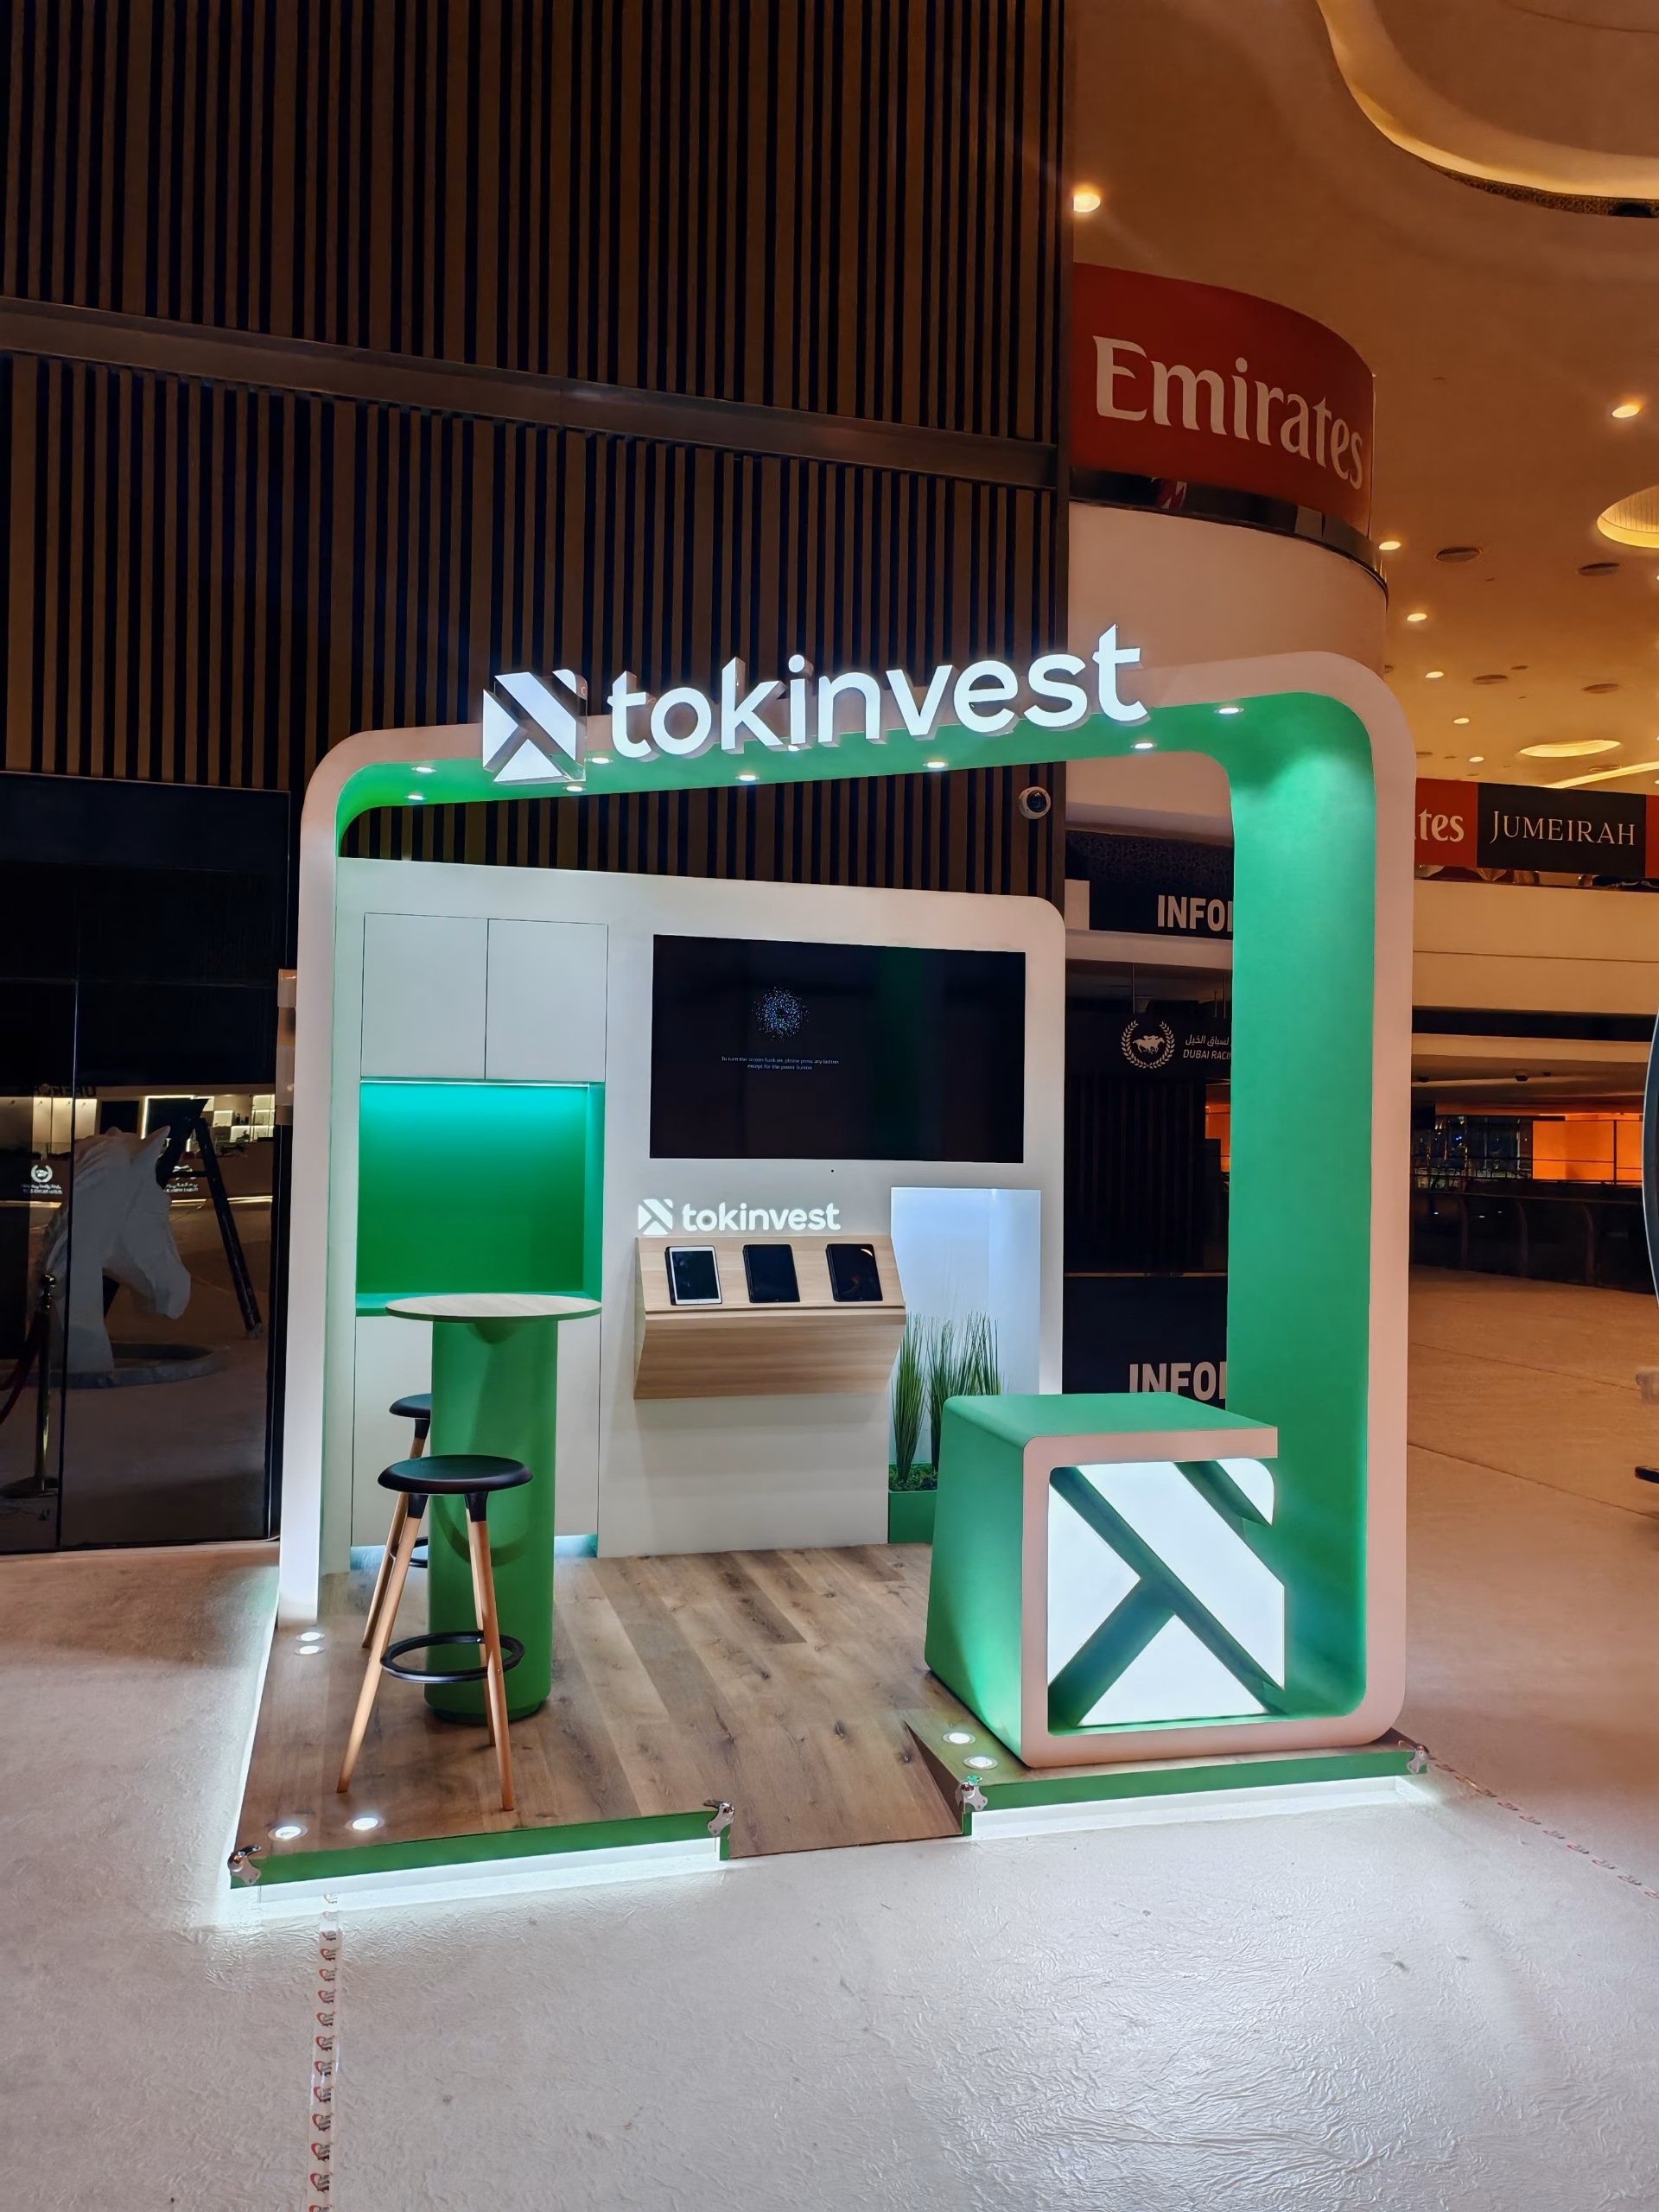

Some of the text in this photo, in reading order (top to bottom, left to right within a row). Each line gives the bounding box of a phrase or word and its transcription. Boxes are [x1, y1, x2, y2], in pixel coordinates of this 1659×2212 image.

[1092, 335, 1363, 490] Emirates
[607, 623, 1147, 758] tokinvest
[1414, 808, 1465, 842] tes
[1489, 810, 1636, 846] JUMEIRAH
[1182, 1049, 1210, 1059] DUBAI
[682, 1202, 842, 1232] tokinvest
